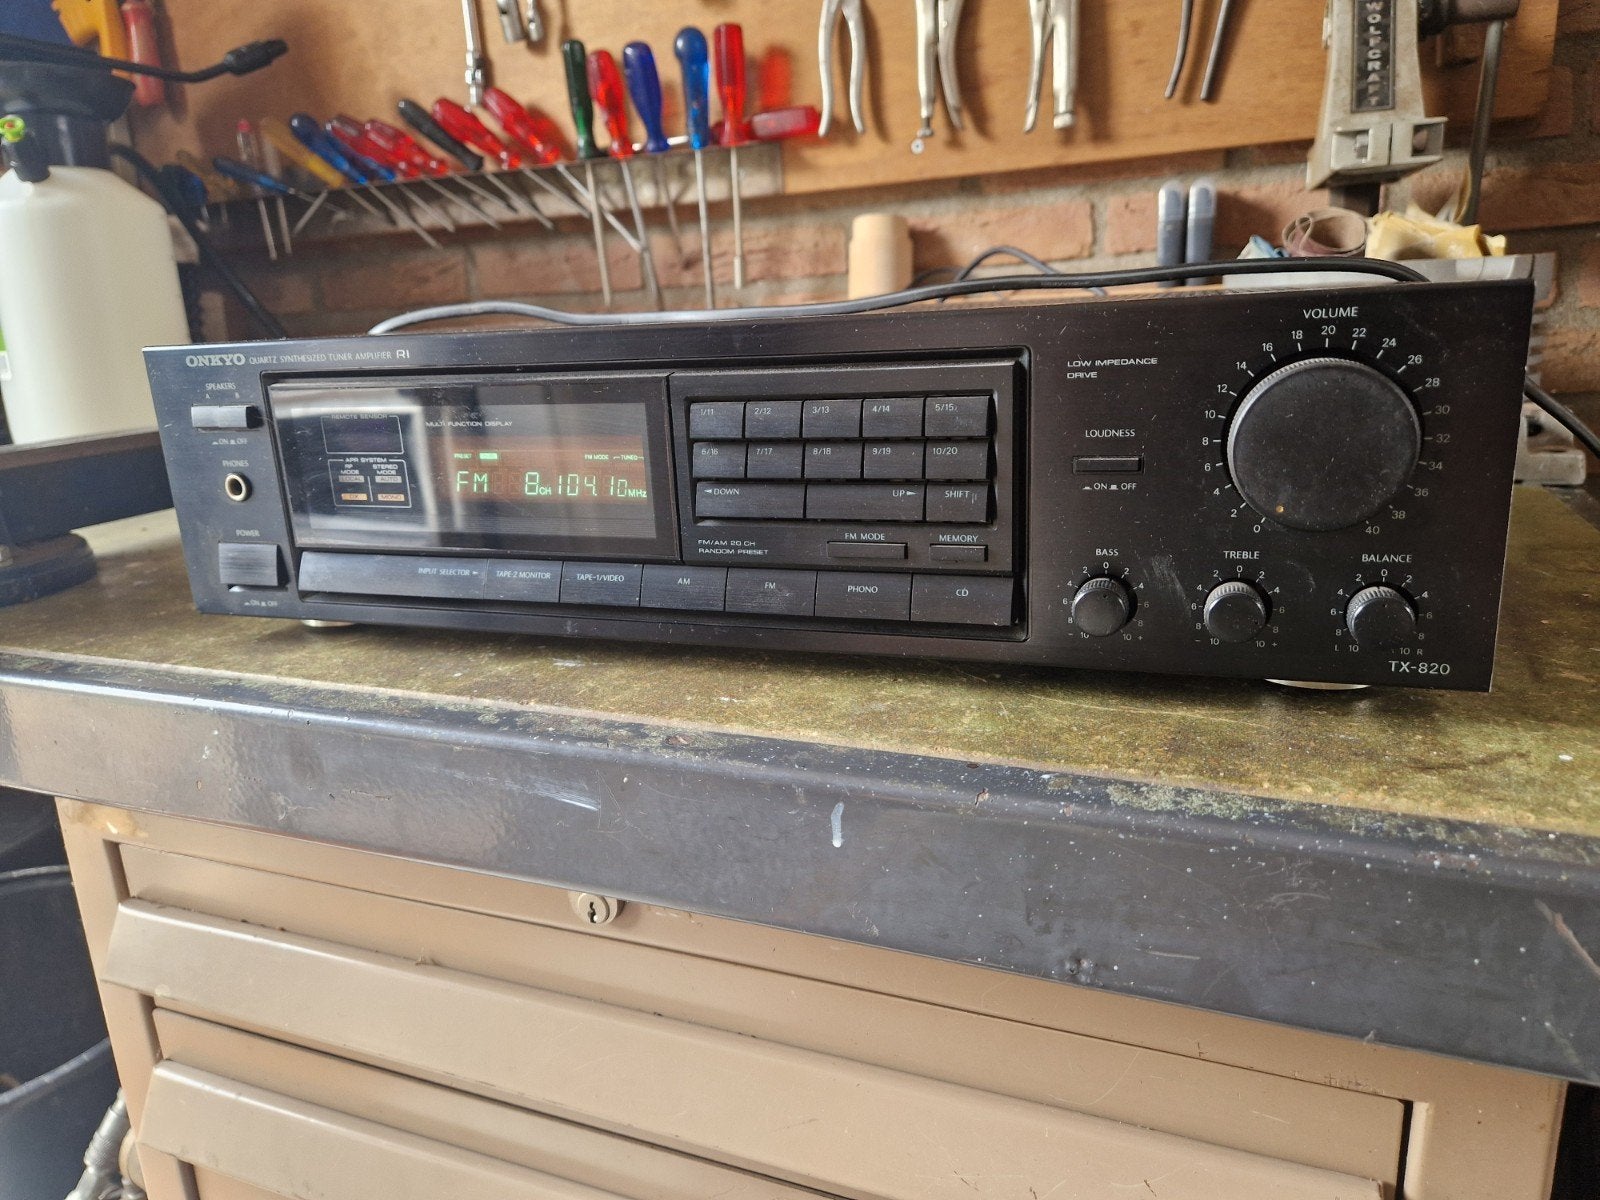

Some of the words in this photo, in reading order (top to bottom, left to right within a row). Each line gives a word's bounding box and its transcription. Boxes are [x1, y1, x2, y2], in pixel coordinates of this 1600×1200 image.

[1303, 306, 1359, 319] VOLUME
[1321, 325, 1336, 335] 20
[1352, 328, 1366, 338] 22
[1291, 330, 1303, 340] 18
[1262, 343, 1273, 352] 16
[1382, 338, 1397, 348] 24
[185, 353, 246, 367] ONKYO
[249, 356, 278, 365] QUARTZ
[280, 354, 326, 364] SYNTHESIZED
[327, 352, 353, 361] TUNER
[355, 351, 392, 360] AMPLIFIER
[1067, 360, 1092, 368] LOW
[1095, 357, 1158, 367] IMPEDANCE
[1408, 355, 1423, 365] 26
[1236, 362, 1247, 371] 14
[1067, 371, 1098, 379] DRIVE
[205, 382, 237, 391] SPEAKERS
[1425, 378, 1440, 388] 28
[1217, 384, 1228, 393] 12
[700, 408, 714, 416] 1/11
[754, 407, 772, 415] 2/12
[812, 405, 830, 414] 3/13
[872, 404, 890, 413] 4/14
[935, 403, 954, 412] 5/15
[1435, 405, 1450, 415] 30
[1204, 410, 1216, 419] 10
[1085, 428, 1136, 438] LOUDNESS
[1202, 437, 1209, 446] 8
[1436, 433, 1450, 443] 32
[701, 448, 719, 456] 6/16
[756, 447, 773, 455] 7/17
[812, 447, 831, 455] 8/18
[872, 447, 891, 455] 9/19
[932, 447, 958, 455] 10/20
[1204, 463, 1211, 472] 6
[1428, 461, 1443, 471] 34
[456, 471, 489, 494] FM
[1093, 482, 1108, 490] ON
[1121, 482, 1137, 490] OFF
[713, 488, 740, 496] DOWN
[892, 489, 905, 498] UP
[944, 489, 970, 498] SHIFT
[1213, 488, 1220, 496] 4
[1414, 487, 1429, 497] 36
[1230, 509, 1237, 518] 2
[1391, 510, 1406, 520] 38
[235, 529, 260, 537] POWER
[1253, 524, 1261, 533] 0
[1365, 525, 1380, 535] 40
[844, 533, 858, 541] FM
[860, 533, 885, 541] MODE
[939, 534, 978, 543] MEMORY
[698, 547, 735, 555] RANDOM
[1095, 548, 1119, 556] BASS
[1223, 550, 1260, 560] TREBLE
[1361, 553, 1413, 563] BALANCE
[1103, 561, 1109, 569] 0
[1236, 565, 1243, 573] 0
[418, 567, 437, 575] INPUT
[439, 568, 470, 576] SELECTOR
[496, 570, 518, 578] TAPE-2
[519, 571, 551, 579] MONITOR
[1082, 566, 1088, 574] 2
[1124, 567, 1130, 575] 2
[1213, 569, 1219, 577] 2
[1380, 568, 1387, 576] 0
[577, 574, 625, 582] TAPE-1/VIDEO
[677, 578, 691, 586] AM
[764, 581, 776, 589] FM
[847, 585, 878, 593] PHONO
[1138, 582, 1144, 590] 4
[1196, 584, 1202, 592] 4
[956, 588, 969, 597] CD
[1274, 586, 1280, 594] 4
[1279, 606, 1285, 614] 6
[1137, 619, 1144, 627] 8
[1195, 622, 1201, 630] 8
[1272, 626, 1279, 634] 8
[1122, 633, 1132, 641] 10
[1418, 632, 1425, 640] 8
[1210, 637, 1220, 645] 10
[1255, 640, 1265, 648] 10
[1399, 647, 1410, 655] 10
[1388, 660, 1450, 675] TX-820
